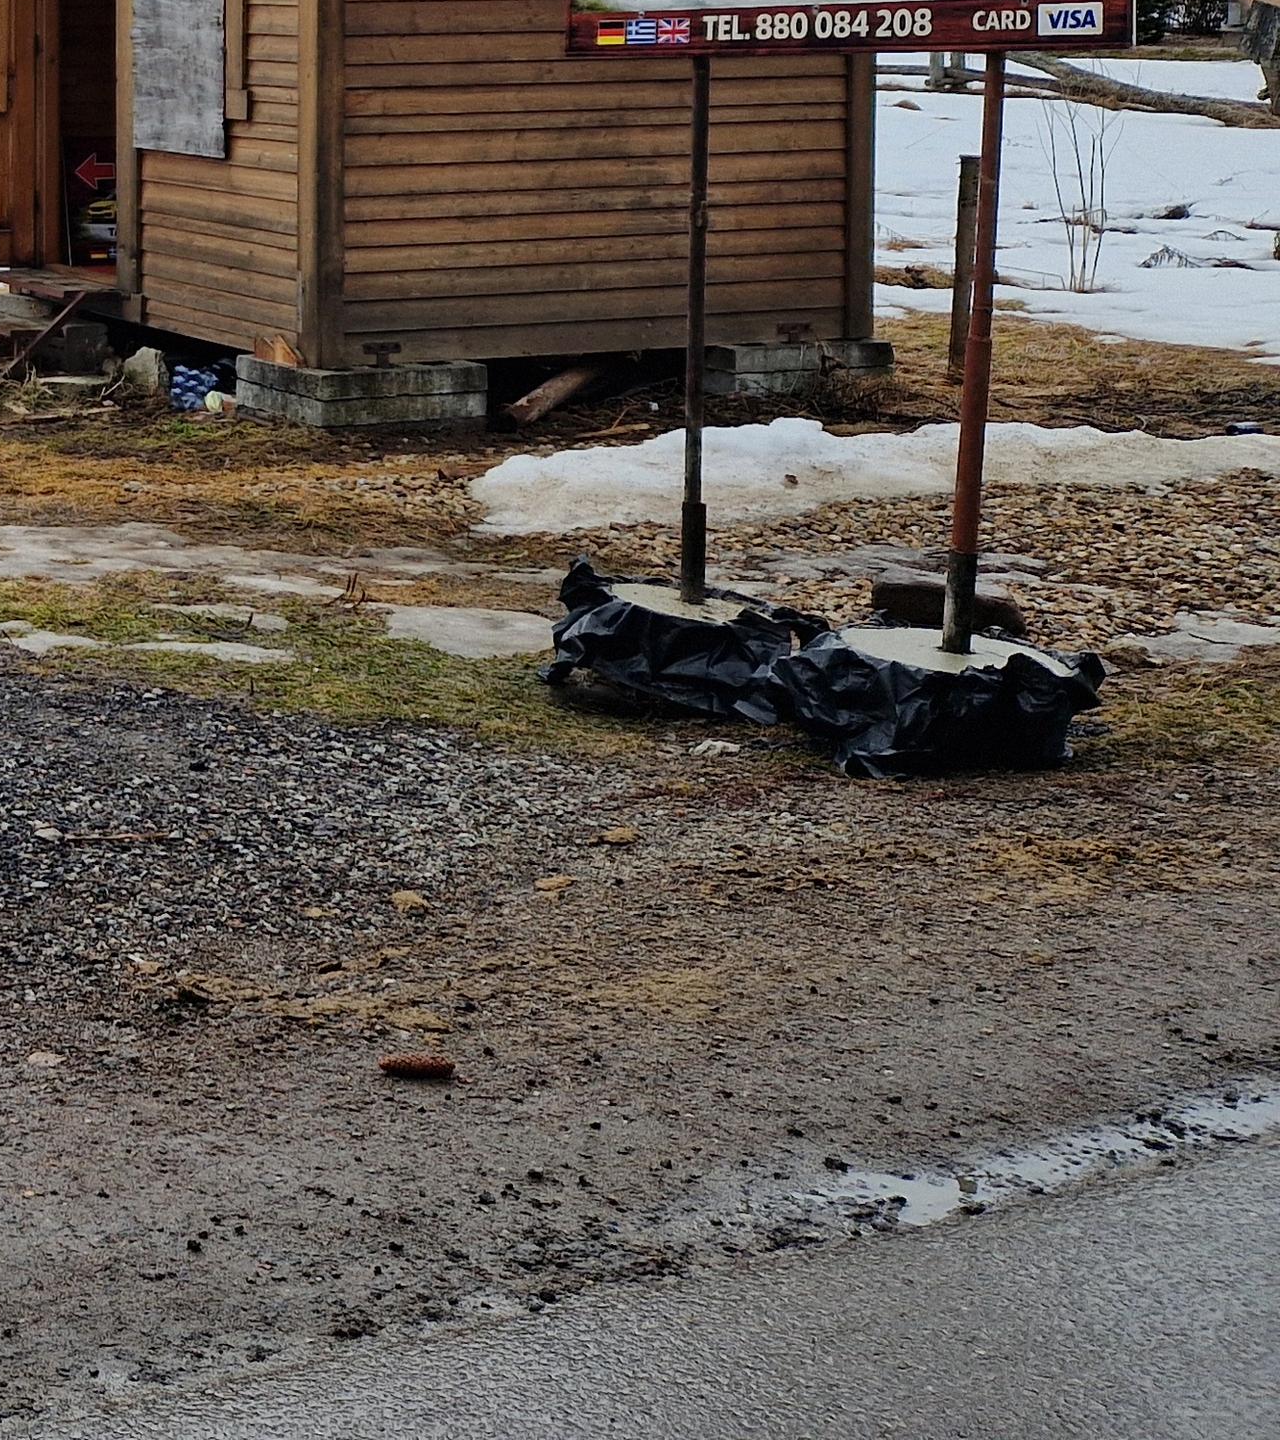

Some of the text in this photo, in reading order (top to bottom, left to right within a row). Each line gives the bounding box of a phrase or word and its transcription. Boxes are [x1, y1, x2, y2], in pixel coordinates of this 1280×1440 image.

[702, 7, 933, 41] TEL. 880 084 208
[972, 9, 1032, 32] CARD
[1046, 8, 1097, 30] VISA
